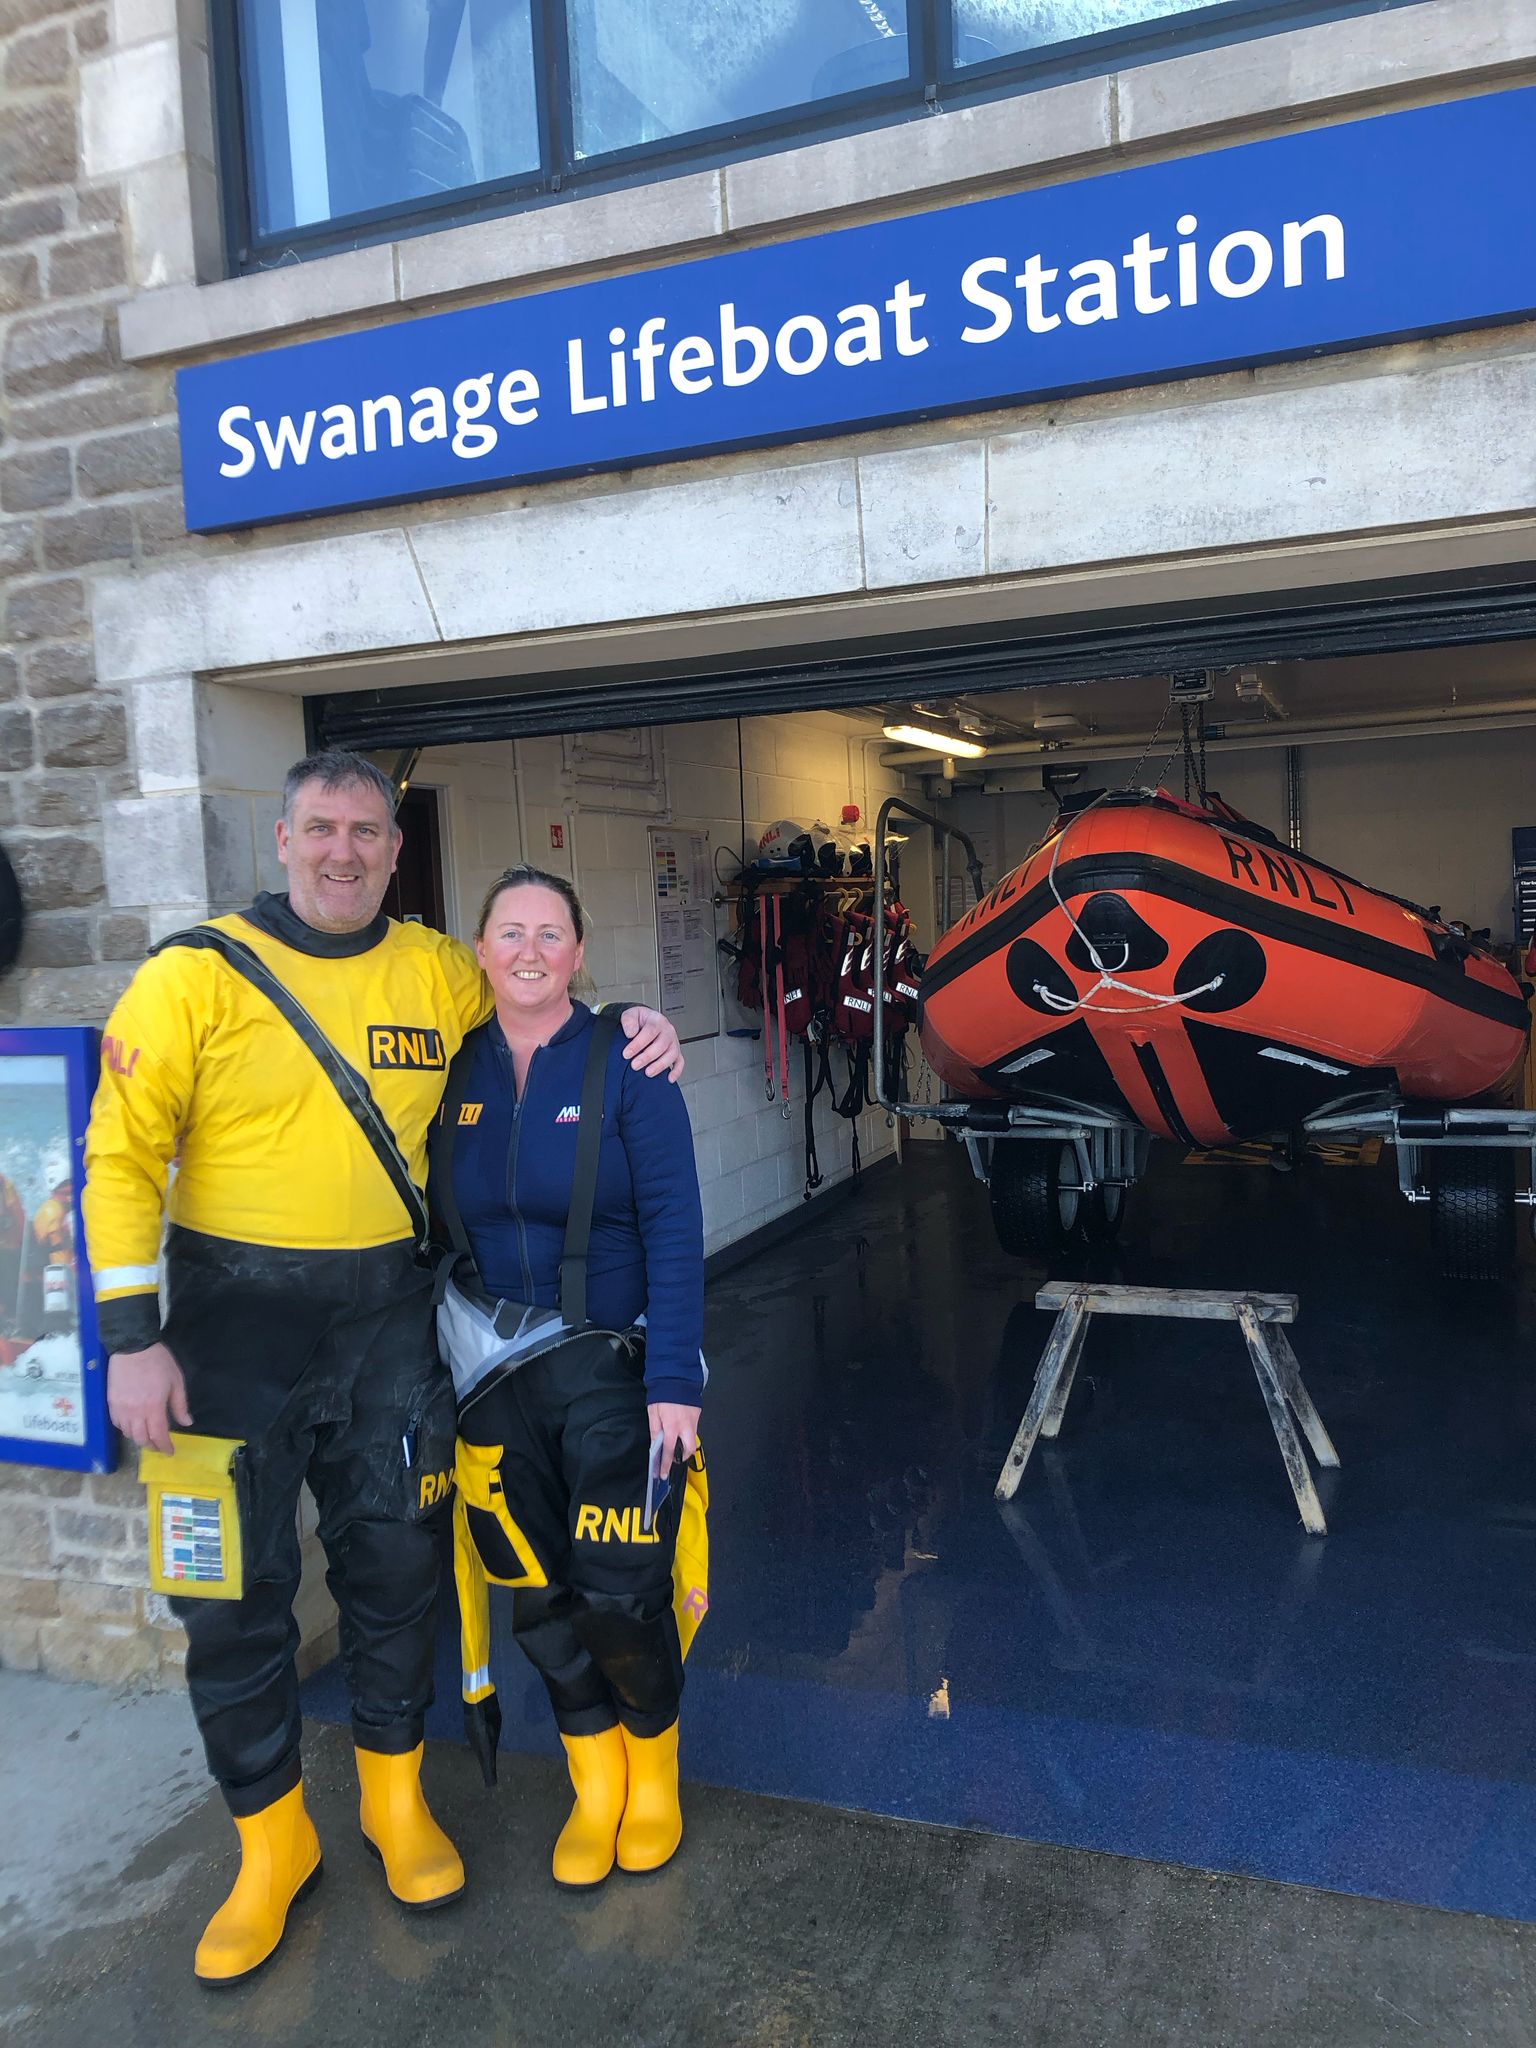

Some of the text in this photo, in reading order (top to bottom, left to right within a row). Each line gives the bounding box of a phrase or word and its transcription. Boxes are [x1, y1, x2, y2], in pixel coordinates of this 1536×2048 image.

[217, 214, 1345, 478] Swanage Lifeboat Station
[1219, 834, 1355, 915] RNLI
[784, 989, 798, 1003] NLI
[847, 997, 870, 1011] RNLI
[372, 1029, 443, 1066] RNLI
[419, 1467, 454, 1509] RN
